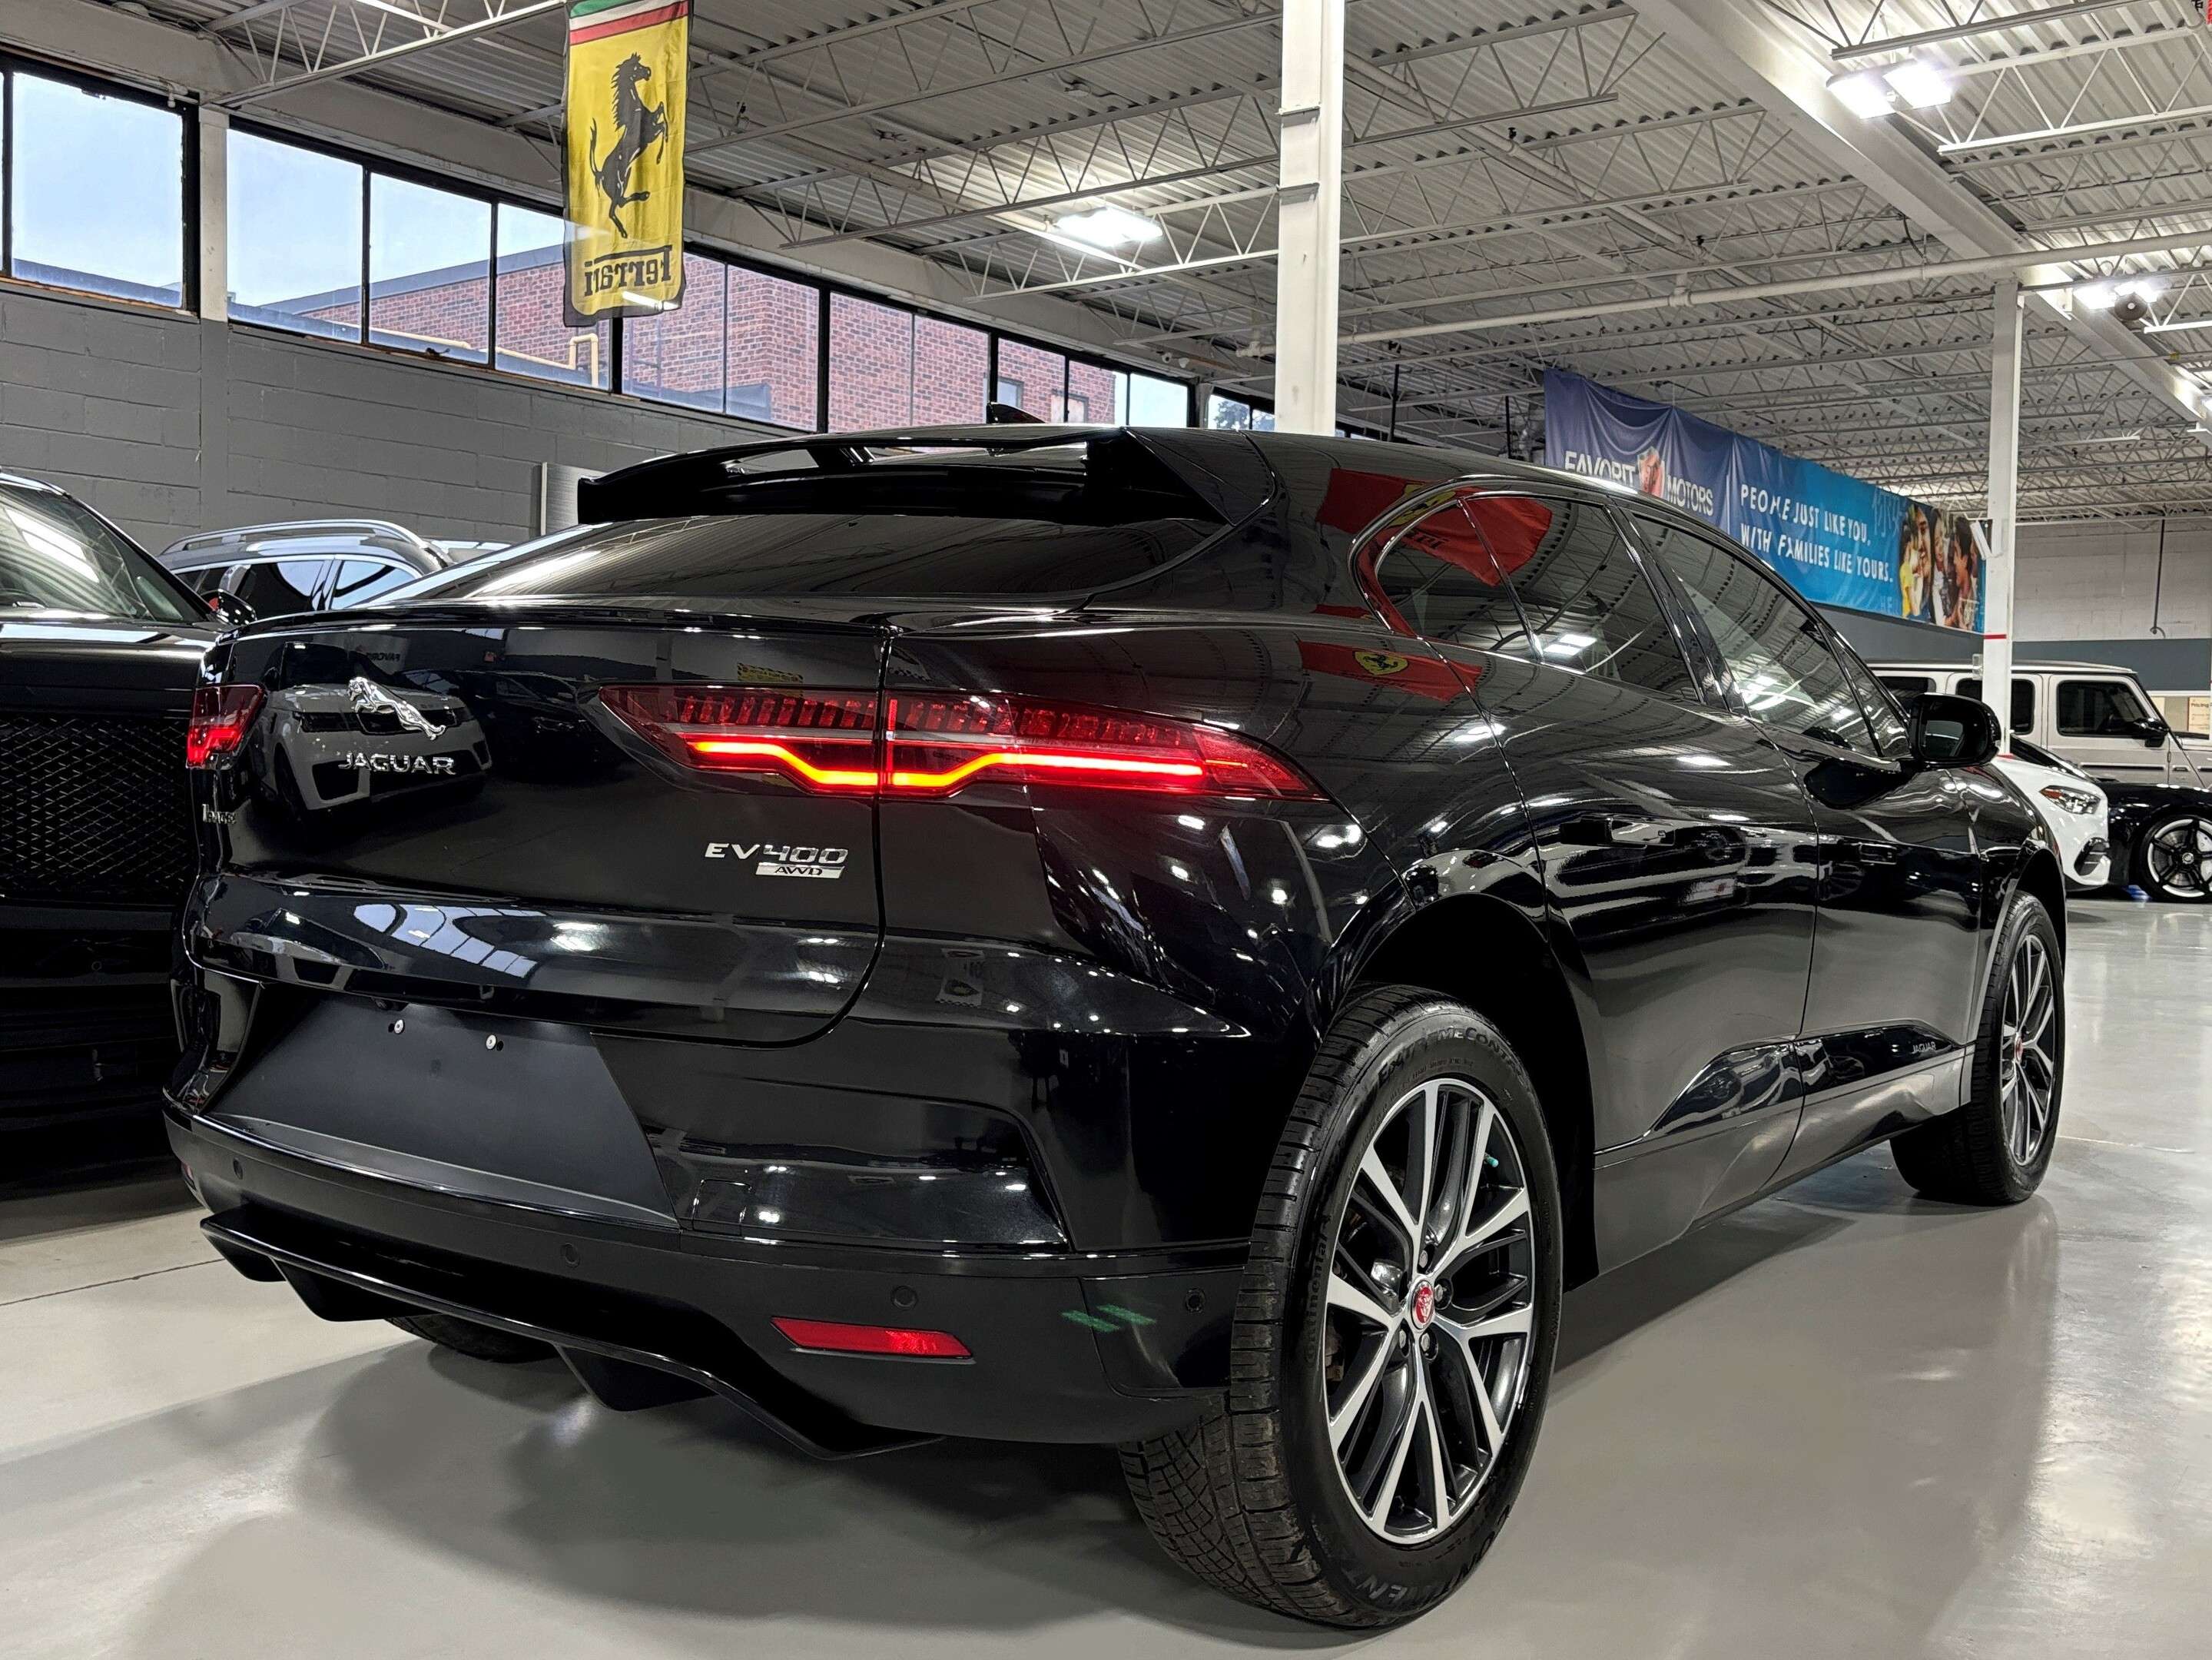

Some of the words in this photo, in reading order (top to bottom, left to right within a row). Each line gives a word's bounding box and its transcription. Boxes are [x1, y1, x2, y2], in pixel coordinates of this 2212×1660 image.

[1564, 450, 1636, 486] FAVORIT
[1666, 474, 1714, 516] MOTORS
[1792, 502, 1820, 529] JUST
[1824, 510, 1846, 536] LIKE
[1740, 523, 1773, 553] WITH
[1777, 534, 1830, 568] FAMILIES
[1833, 549, 1852, 574] LIKE
[1856, 555, 1894, 583] YOURS.
[338, 752, 456, 775] JAGUAR
[705, 842, 848, 864] EV400
[774, 865, 823, 876] AWD
